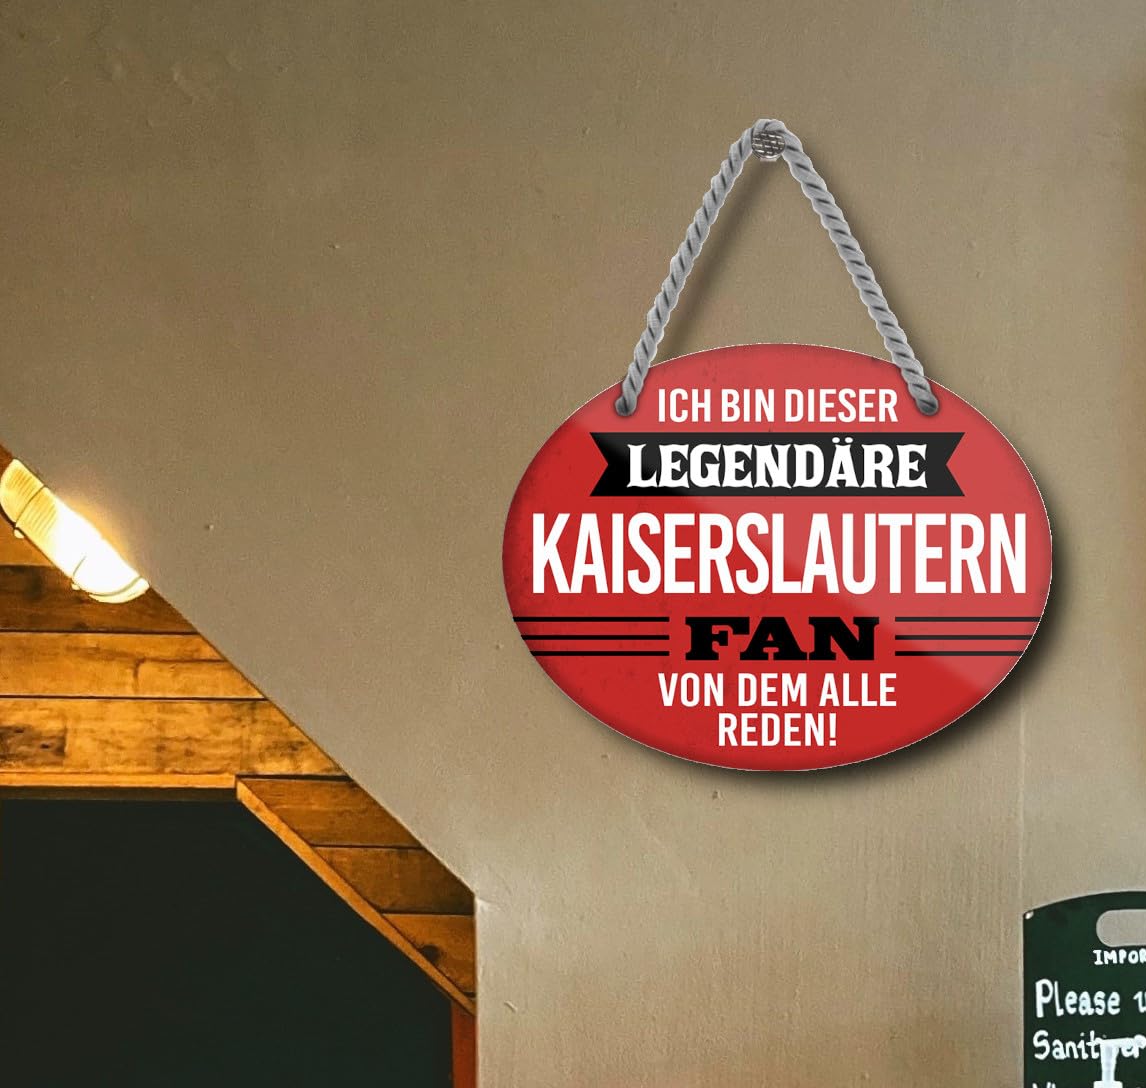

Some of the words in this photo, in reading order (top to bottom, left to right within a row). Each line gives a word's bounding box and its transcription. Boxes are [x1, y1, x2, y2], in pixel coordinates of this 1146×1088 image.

[658, 388, 711, 422] ICH
[721, 388, 774, 422] BIN
[785, 388, 898, 422] DIESER
[626, 437, 928, 489] LEGENDÄRE
[531, 512, 1027, 595] KAISERSLAUTERN
[685, 616, 880, 661] FAN
[658, 673, 724, 707] VON
[739, 673, 807, 707] DEM
[819, 673, 897, 707] ALLE
[717, 712, 838, 747] REDEN!
[1034, 978, 1121, 1018] Please
